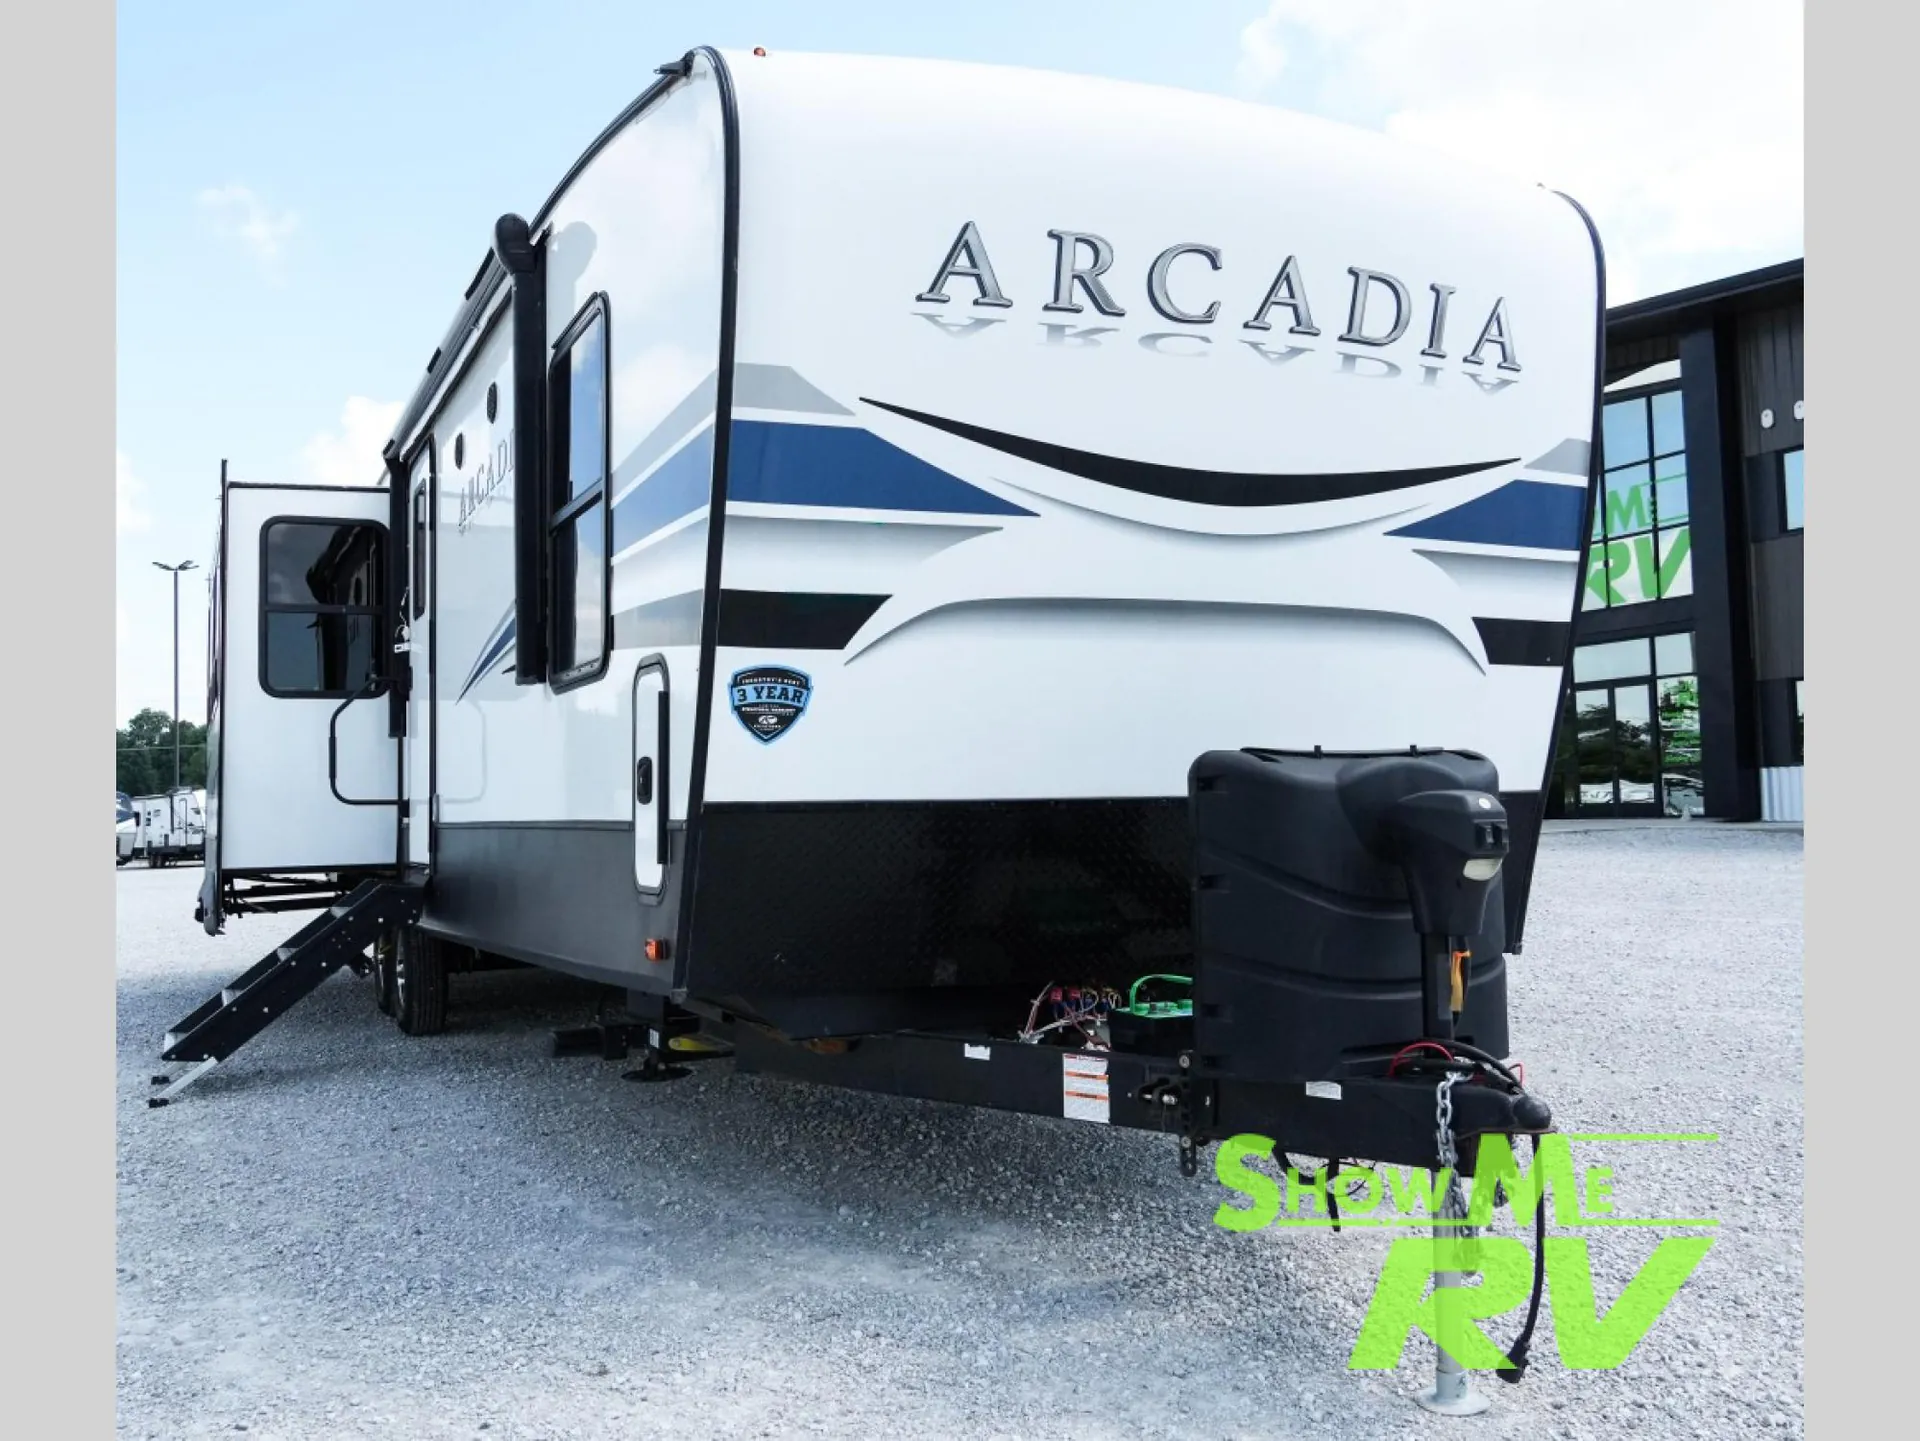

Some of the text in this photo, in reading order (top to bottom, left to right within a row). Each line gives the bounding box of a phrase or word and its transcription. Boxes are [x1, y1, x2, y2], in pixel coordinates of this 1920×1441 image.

[916, 220, 1522, 372] ARCADIA
[459, 428, 515, 526] ARCADI
[1588, 527, 1691, 605] RV
[737, 685, 804, 703] 3 YEAR
